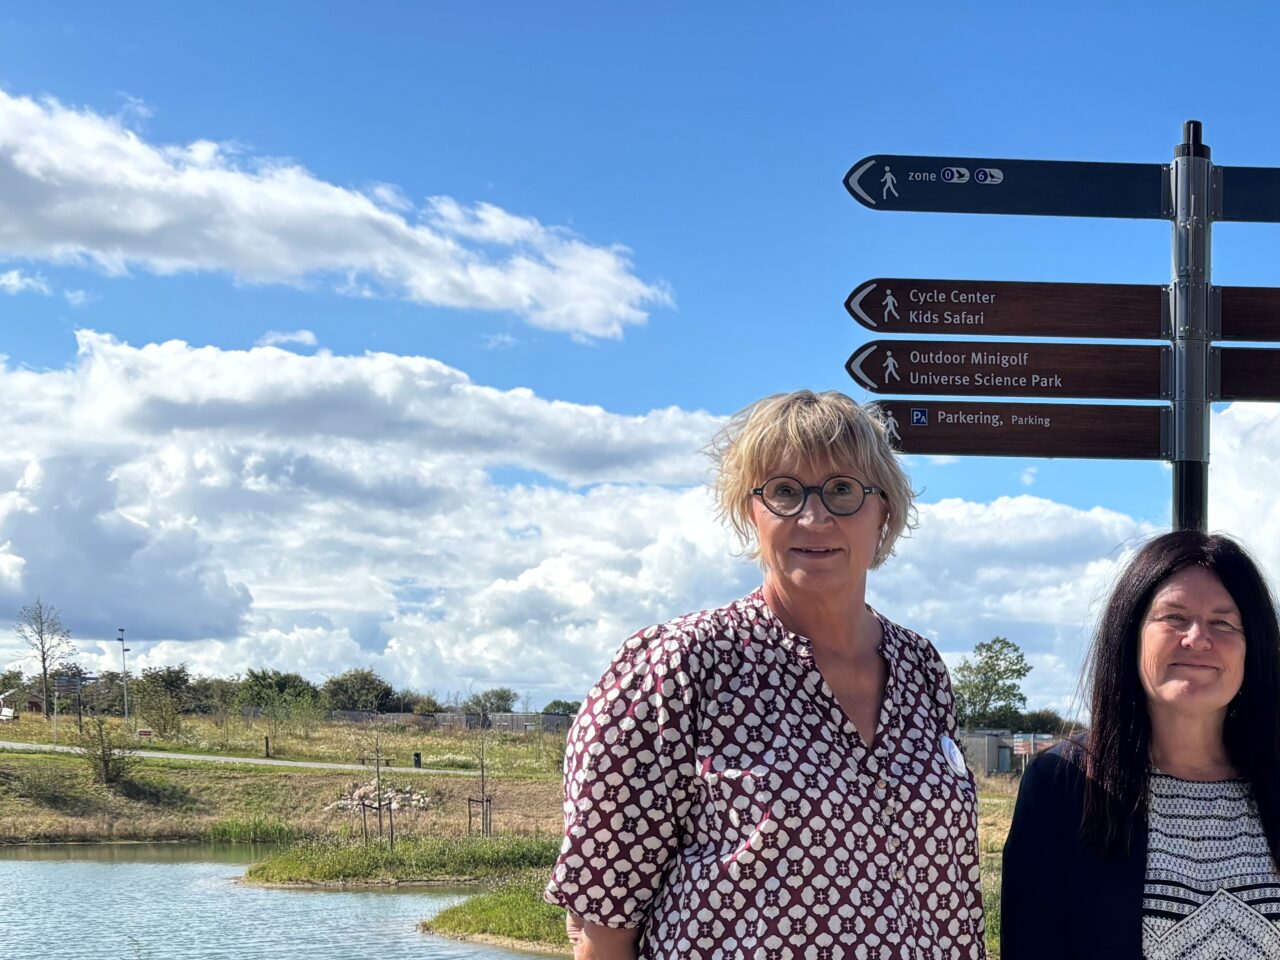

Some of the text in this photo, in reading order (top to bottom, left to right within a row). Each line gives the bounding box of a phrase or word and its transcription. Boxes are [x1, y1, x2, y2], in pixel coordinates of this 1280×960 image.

[908, 172, 937, 181] zone
[909, 289, 996, 305] Cycle Center
[909, 310, 984, 324] Kids Safari
[910, 350, 1029, 368] Outdoor Minigolf
[910, 371, 1062, 387] Universe Science Park
[938, 410, 1004, 427] Parkering,
[1011, 415, 1051, 427] Parking
